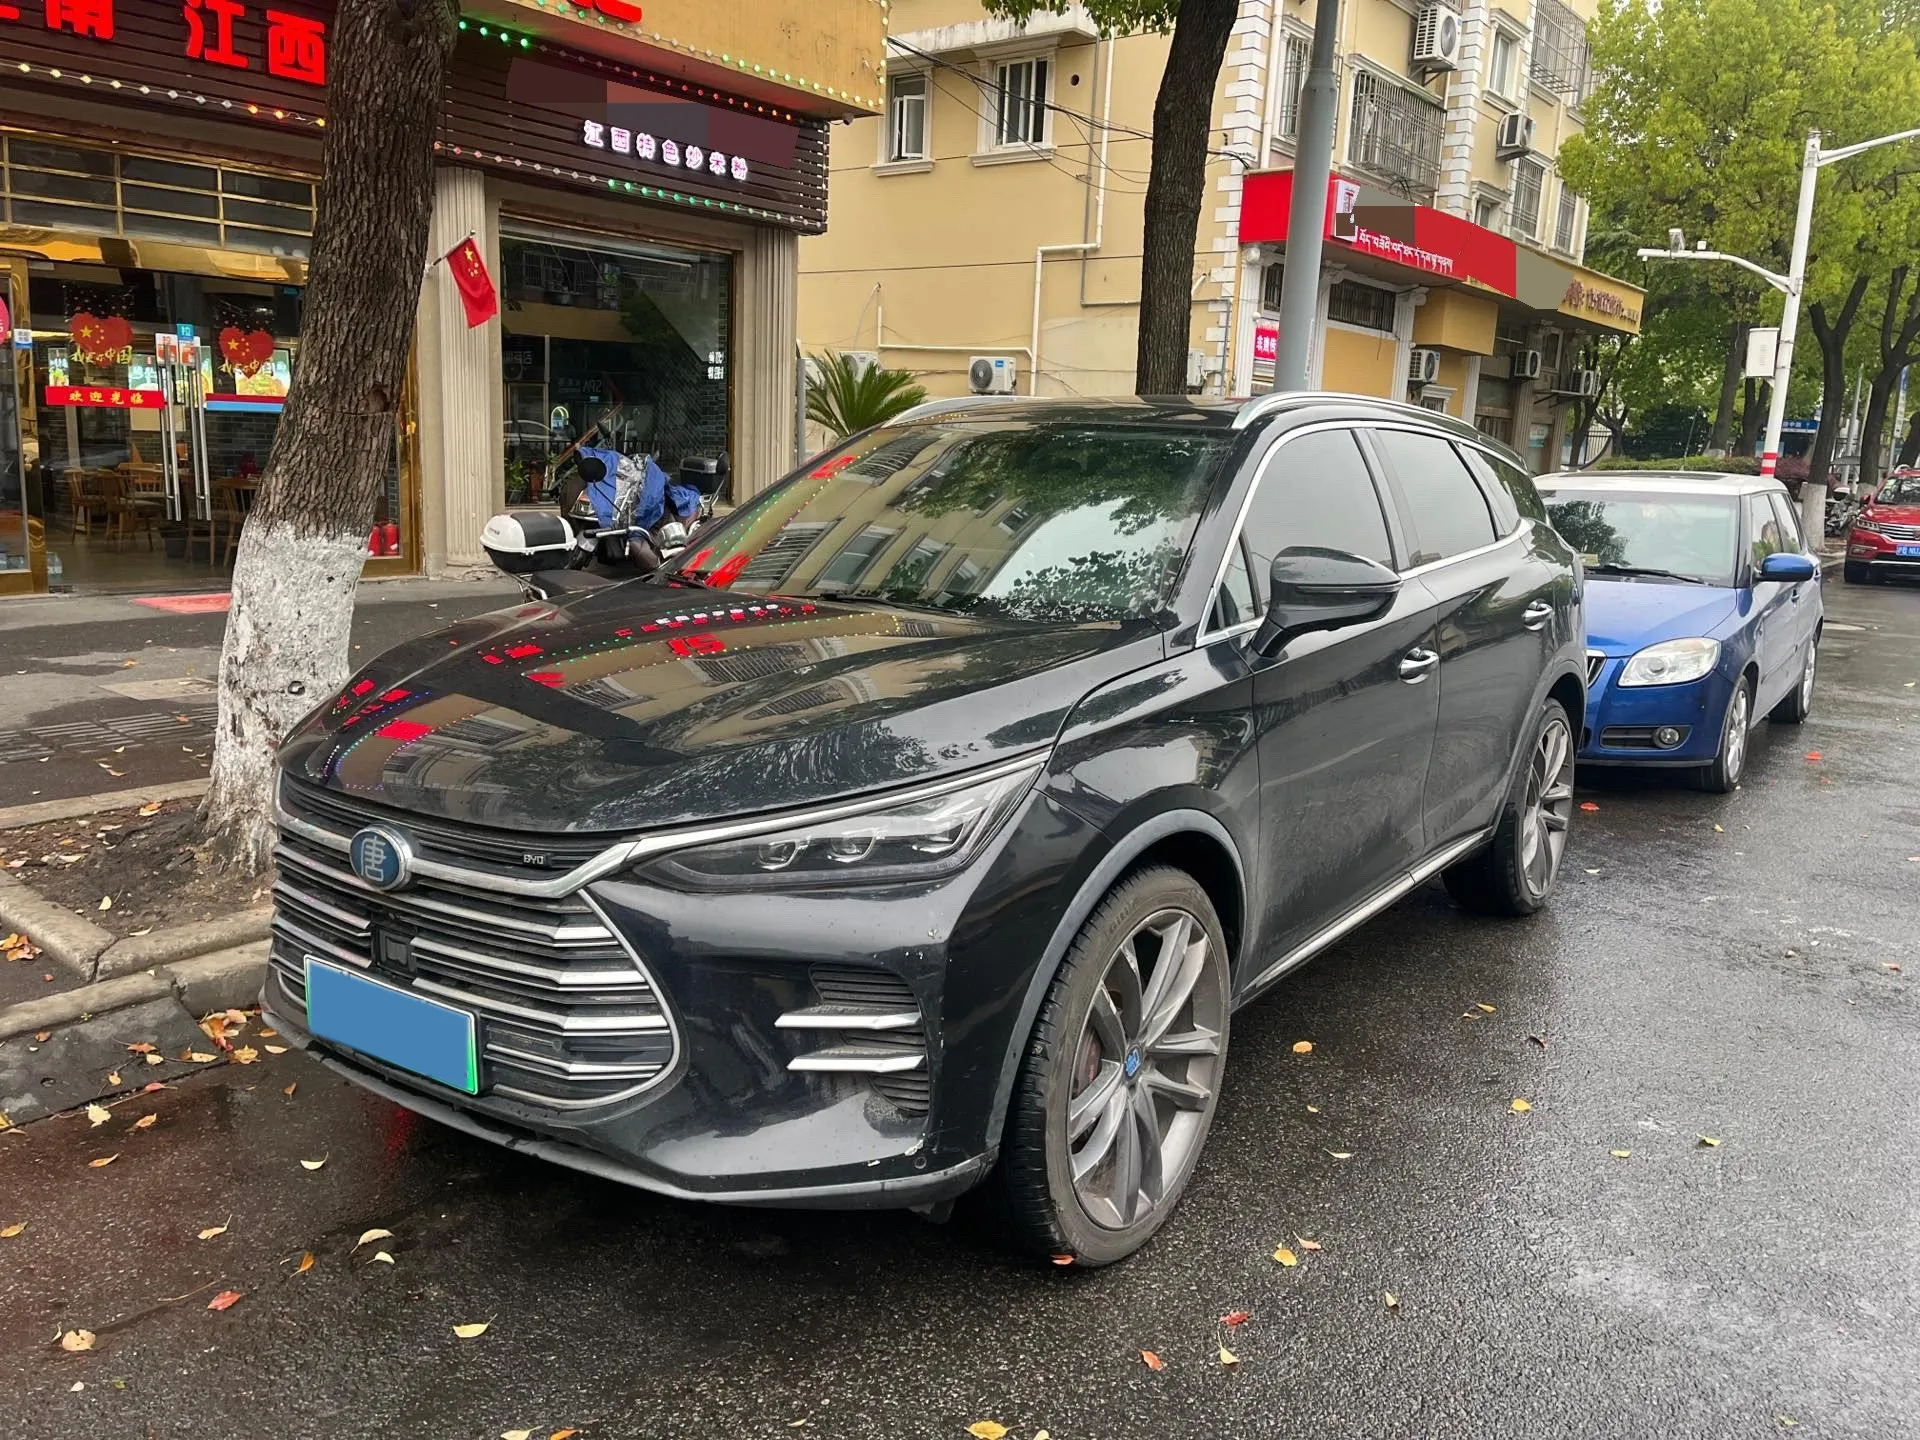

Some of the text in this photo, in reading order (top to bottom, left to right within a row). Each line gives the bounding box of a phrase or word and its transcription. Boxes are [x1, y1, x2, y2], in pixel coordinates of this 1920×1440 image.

[184, 0, 326, 85] 江西
[583, 119, 748, 181] 江西特色炒米粉
[69, 390, 145, 405] 欢迎光临
